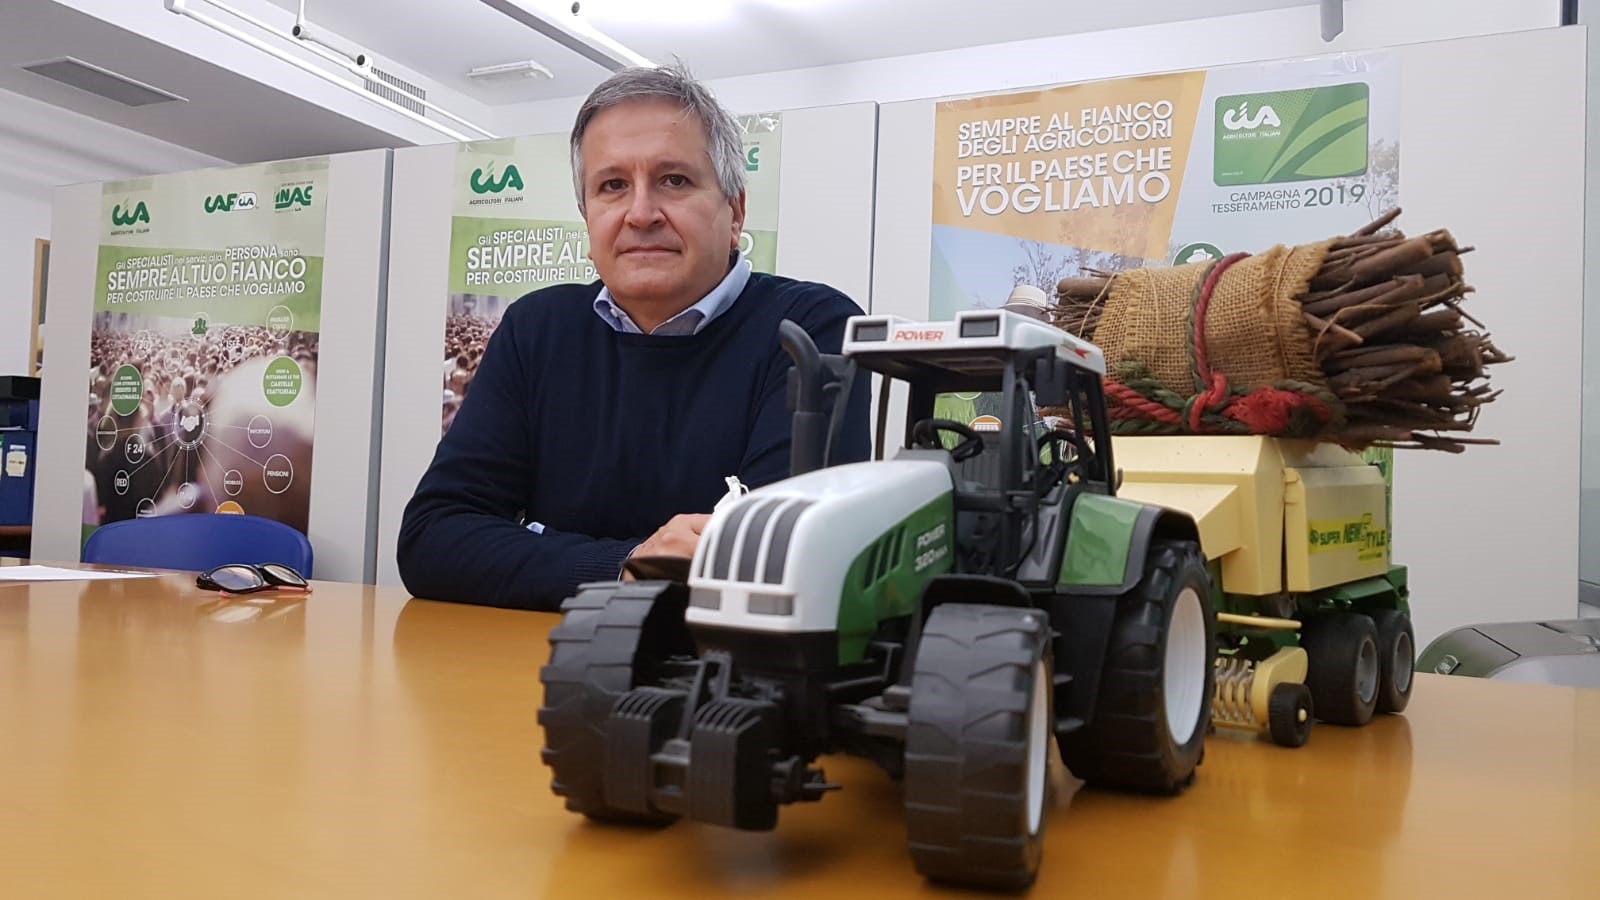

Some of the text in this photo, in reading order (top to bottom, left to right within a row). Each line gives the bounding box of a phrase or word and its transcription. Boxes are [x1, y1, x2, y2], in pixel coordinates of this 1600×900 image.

[958, 99, 1173, 141] SEMPRE AL FIANCO
[958, 118, 1173, 159] DEGLI AGRICOLTORI
[957, 146, 1173, 188] PER IL PAESE CHE
[204, 193, 238, 213] CAF
[956, 170, 1171, 217] VOGLIAMO
[1230, 188, 1301, 203] CAMPAGNA
[1303, 183, 1366, 208] 2019
[1211, 199, 1301, 214] TESSERAMENTO
[493, 227, 564, 244] SPECIALISTI
[565, 230, 578, 240] nei
[127, 254, 174, 269] SPECIALISTI
[225, 246, 278, 260] PERSONA
[467, 241, 586, 270] SEMPRE AL
[108, 258, 306, 291] SEMPRE AL TUO FIANCO
[466, 270, 490, 286] PER
[493, 267, 565, 284] COSTRUIRE
[569, 267, 580, 281] IL
[107, 281, 305, 305] PER COSTRUIRE IL PAESE CHE VOGLIAMO
[894, 331, 944, 342] POWER
[133, 443, 143, 454] 24
[116, 478, 127, 487] RED
